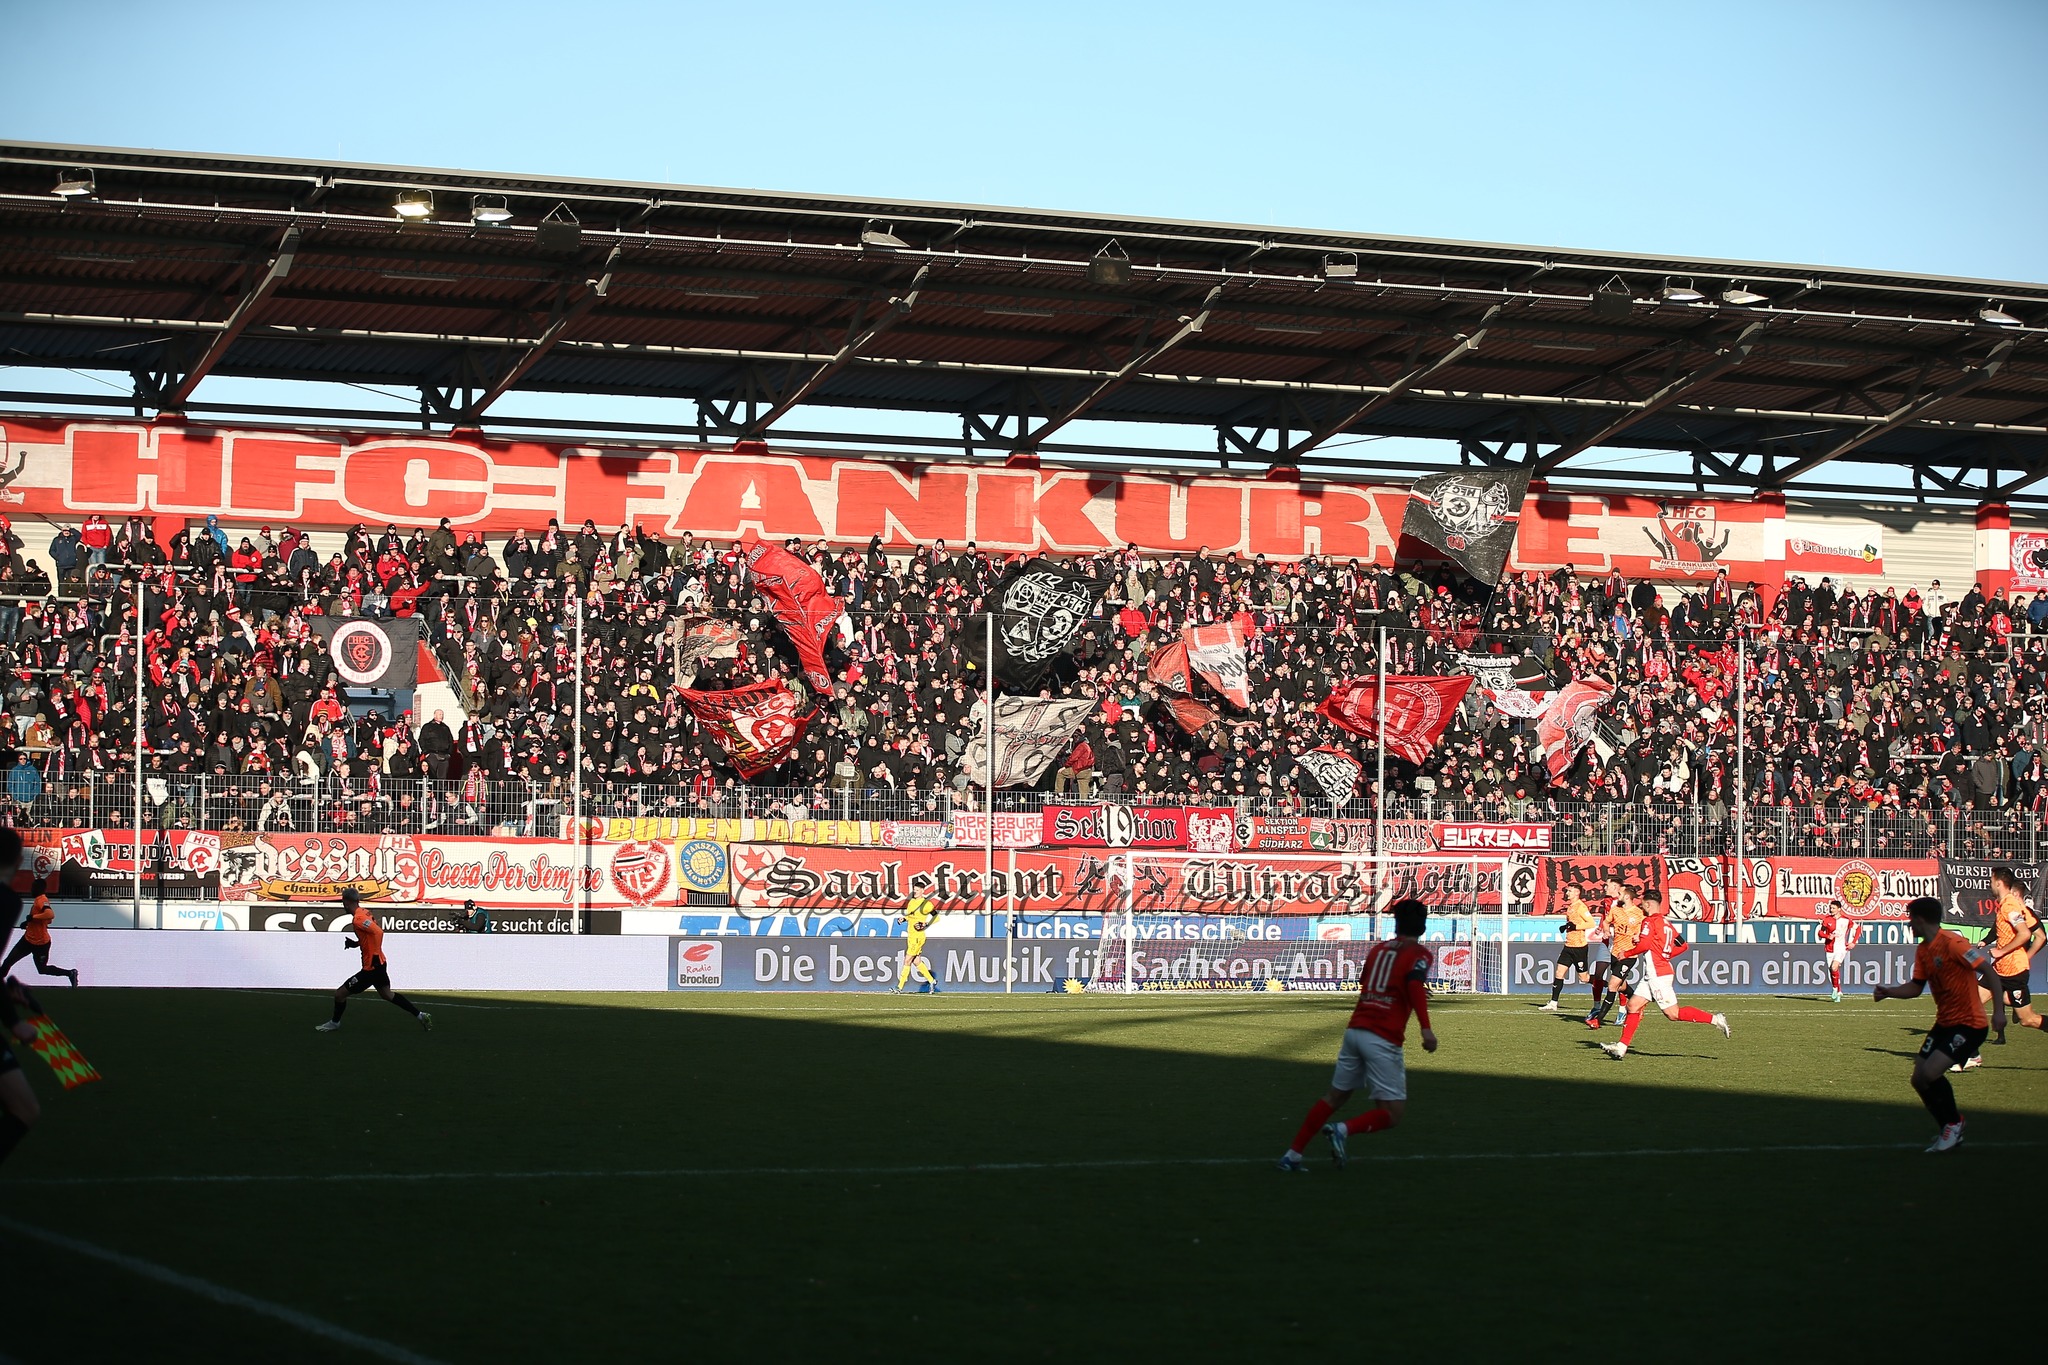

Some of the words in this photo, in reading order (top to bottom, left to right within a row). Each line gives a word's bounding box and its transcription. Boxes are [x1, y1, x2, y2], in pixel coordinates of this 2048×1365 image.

[1672, 506, 1707, 518] HFC
[352, 636, 370, 644] HFC
[1263, 818, 1299, 826] SEKTION
[605, 817, 740, 842] BULLEN
[1256, 826, 1307, 835] MANSFELD
[193, 834, 217, 847] HFC
[1259, 838, 1304, 849] SÜDHARZ
[1443, 825, 1550, 850] SURREALE
[685, 842, 723, 862] FANSZENE
[89, 872, 125, 880] Altmark
[683, 858, 723, 885] LOKOMOTIVE
[1837, 862, 1877, 881] HALLESCHER
[1778, 868, 1833, 897] Leuna
[1879, 869, 1940, 898] Löwen
[178, 910, 216, 920] NORD
[502, 917, 546, 933] sucht
[686, 964, 712, 974] Radio
[755, 945, 814, 982] Die
[830, 944, 932, 982] beste
[945, 944, 1054, 983] Musik
[1367, 949, 1397, 993] 10
[680, 974, 720, 985] Brocken
[1143, 980, 1211, 991] SPIELBANK
[1214, 980, 1254, 990] HALLE
[1287, 982, 1337, 991] MERKUR
